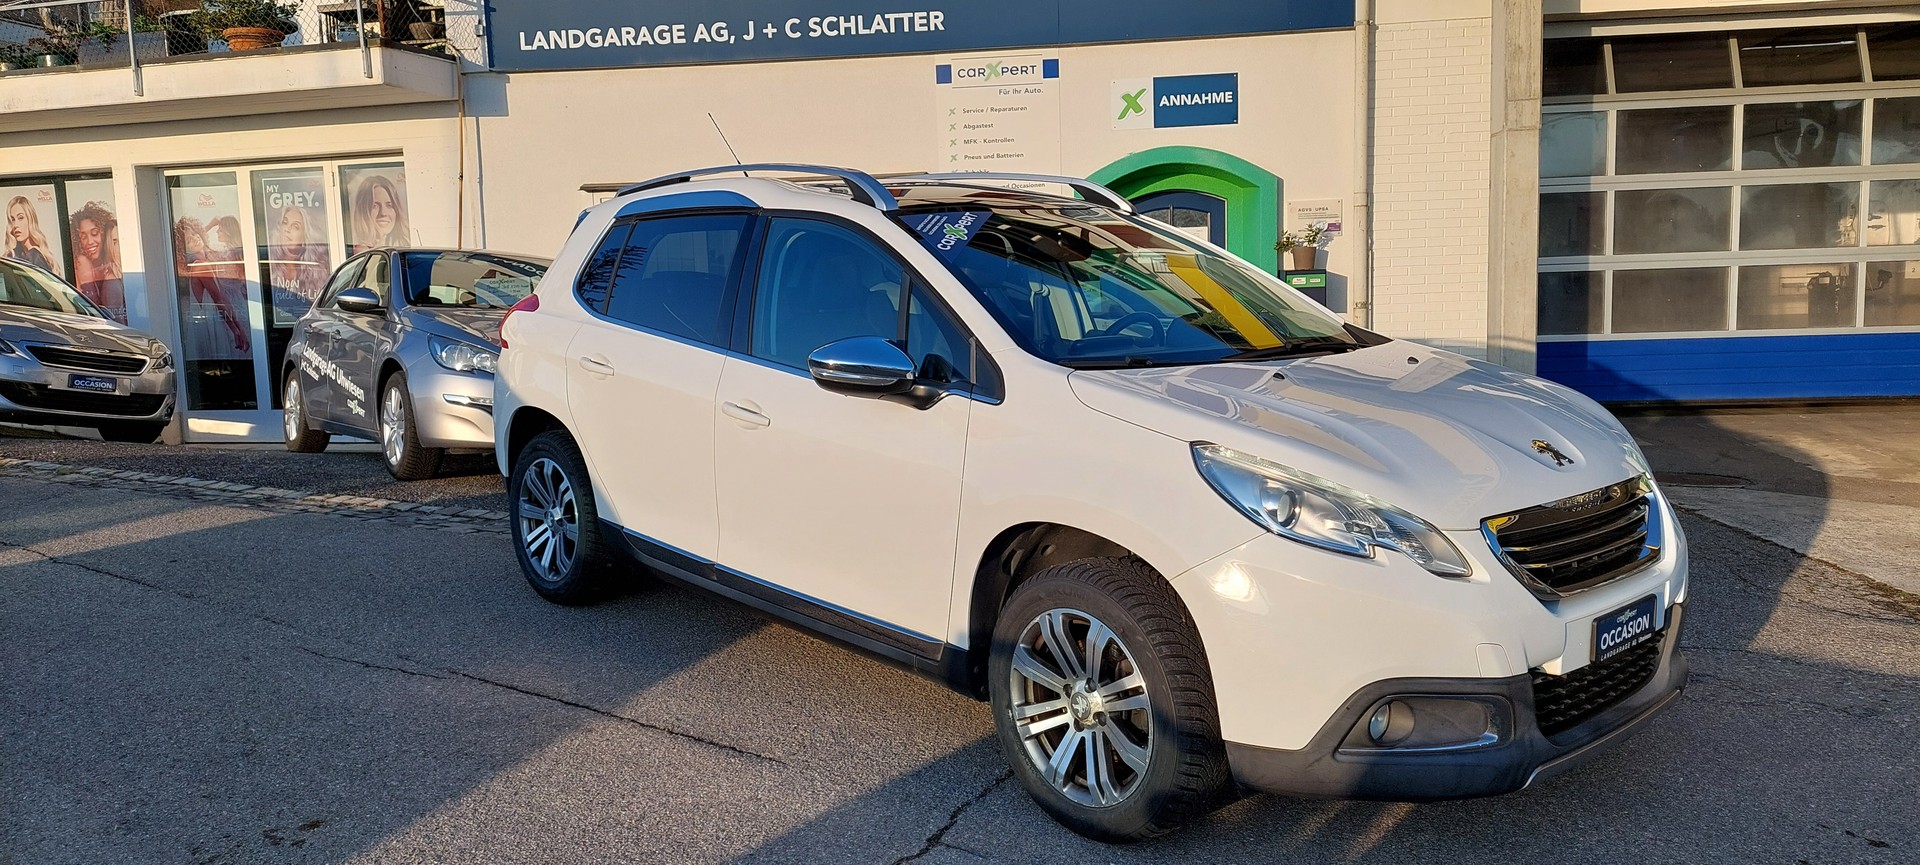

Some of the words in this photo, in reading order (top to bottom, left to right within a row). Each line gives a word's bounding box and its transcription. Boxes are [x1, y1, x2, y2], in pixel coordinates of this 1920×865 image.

[519, 24, 687, 51] LANDGARAGE
[693, 21, 736, 44] AG,
[742, 20, 755, 41] J
[762, 22, 778, 39] +
[784, 17, 802, 39] C
[808, 10, 945, 38] SCHLATTER
[1159, 91, 1233, 107] ANNAHME
[990, 105, 1028, 114] Reparaturen
[266, 184, 280, 193] MY
[269, 191, 320, 209] GREY.
[276, 276, 300, 288] Now
[296, 288, 307, 303] of
[303, 340, 328, 376] Landgarage
[326, 360, 337, 380] AG
[336, 366, 365, 403] Uhwiesen
[74, 379, 113, 389] OCCASION
[1600, 613, 1650, 650] OCCASION
[1600, 641, 1631, 662] LANDGARAGE
